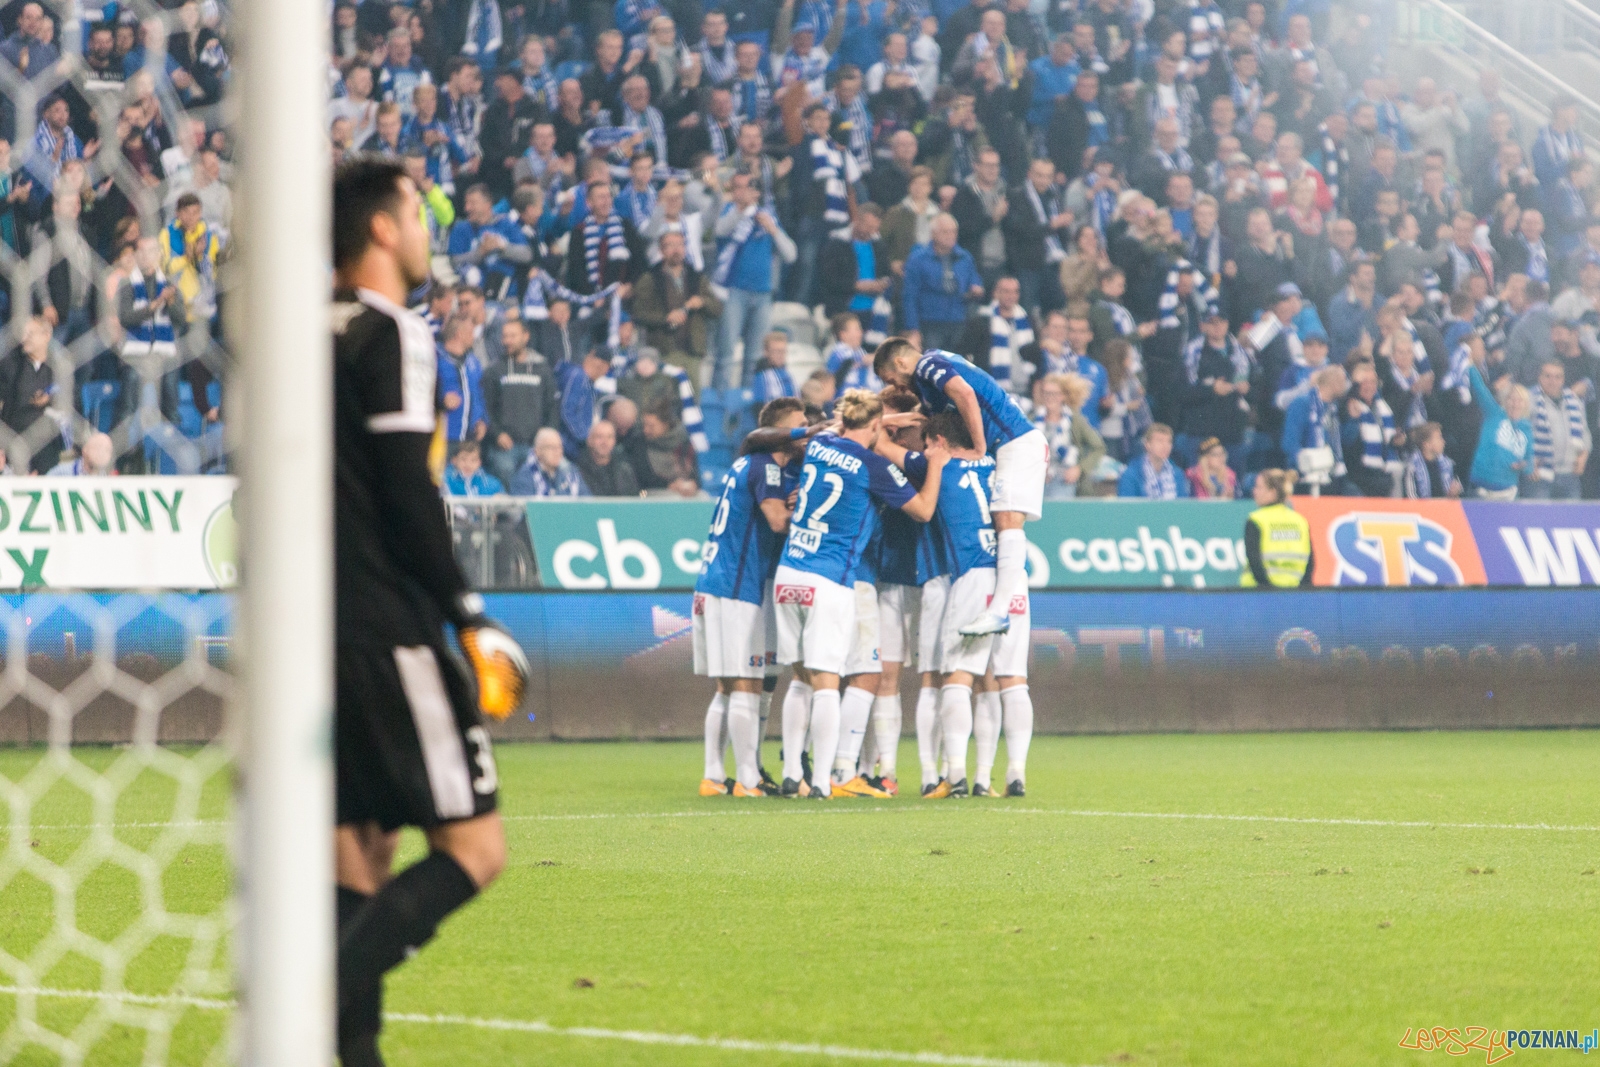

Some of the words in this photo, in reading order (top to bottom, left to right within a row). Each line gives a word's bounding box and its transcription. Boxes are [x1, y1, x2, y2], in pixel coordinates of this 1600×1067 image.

[792, 463, 844, 535] 32
[553, 518, 662, 589] cb
[790, 529, 818, 547] ECH
[1327, 511, 1464, 586] STS
